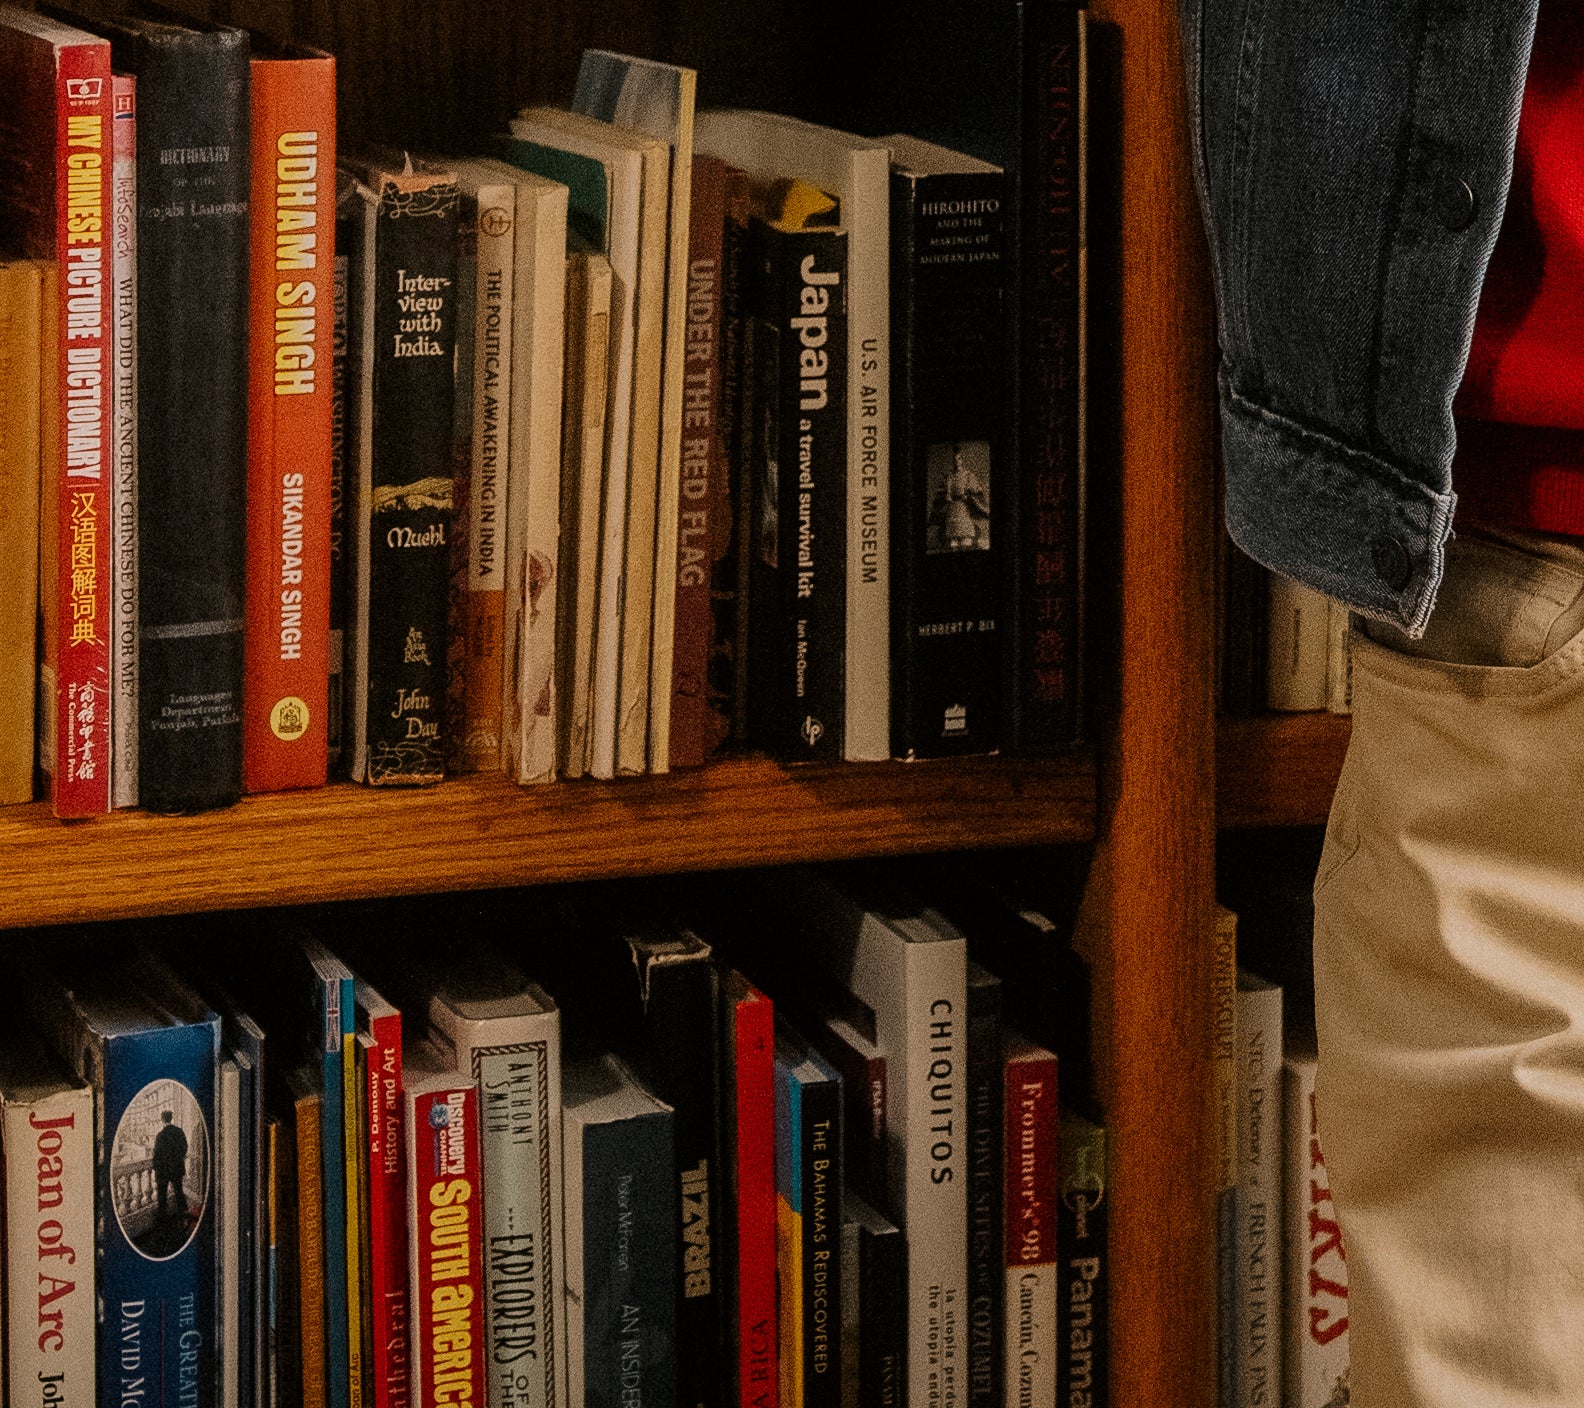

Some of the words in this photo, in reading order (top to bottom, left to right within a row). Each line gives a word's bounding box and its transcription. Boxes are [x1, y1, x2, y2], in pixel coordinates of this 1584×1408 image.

[68, 116, 102, 147] MY
[67, 153, 102, 244] CHINESE
[276, 131, 317, 271] UDHAM
[67, 247, 101, 340] PICTURE
[398, 270, 452, 293] Inter-
[398, 293, 443, 312] view
[274, 281, 316, 395] SINGH
[394, 334, 444, 358] India
[399, 312, 442, 333] with
[790, 253, 841, 411] Japan
[859, 338, 878, 378] U.S.
[67, 348, 101, 479] DICTIONARY
[859, 386, 878, 418] AIR
[859, 425, 878, 486] FORCE
[282, 473, 304, 585] SIKANDAR
[387, 524, 446, 549] Muehl
[859, 495, 878, 584] MUSEUM
[69, 492, 98, 647] 汉语图解词典
[281, 590, 302, 660] SINGH
[392, 688, 430, 718] John
[405, 716, 439, 741] Day
[383, 1047, 396, 1073] Art
[385, 1077, 397, 1103] and
[926, 999, 953, 1184] CHIQUITOS
[485, 1082, 509, 1133] SMITH
[509, 1062, 533, 1146] ANTHONY
[812, 1120, 831, 1156] THE
[28, 1111, 75, 1212] Joan
[384, 1110, 401, 1173] History
[429, 1178, 472, 1281] SOUTH
[813, 1160, 831, 1242] BAHAMAS
[37, 1219, 76, 1265] of
[36, 1272, 77, 1353] Arc
[121, 1299, 145, 1371] DAVID
[489, 1235, 537, 1365] EXPLORERS
[814, 1250, 830, 1374] REDISCOVERED
[1069, 1256, 1101, 1408] Panama
